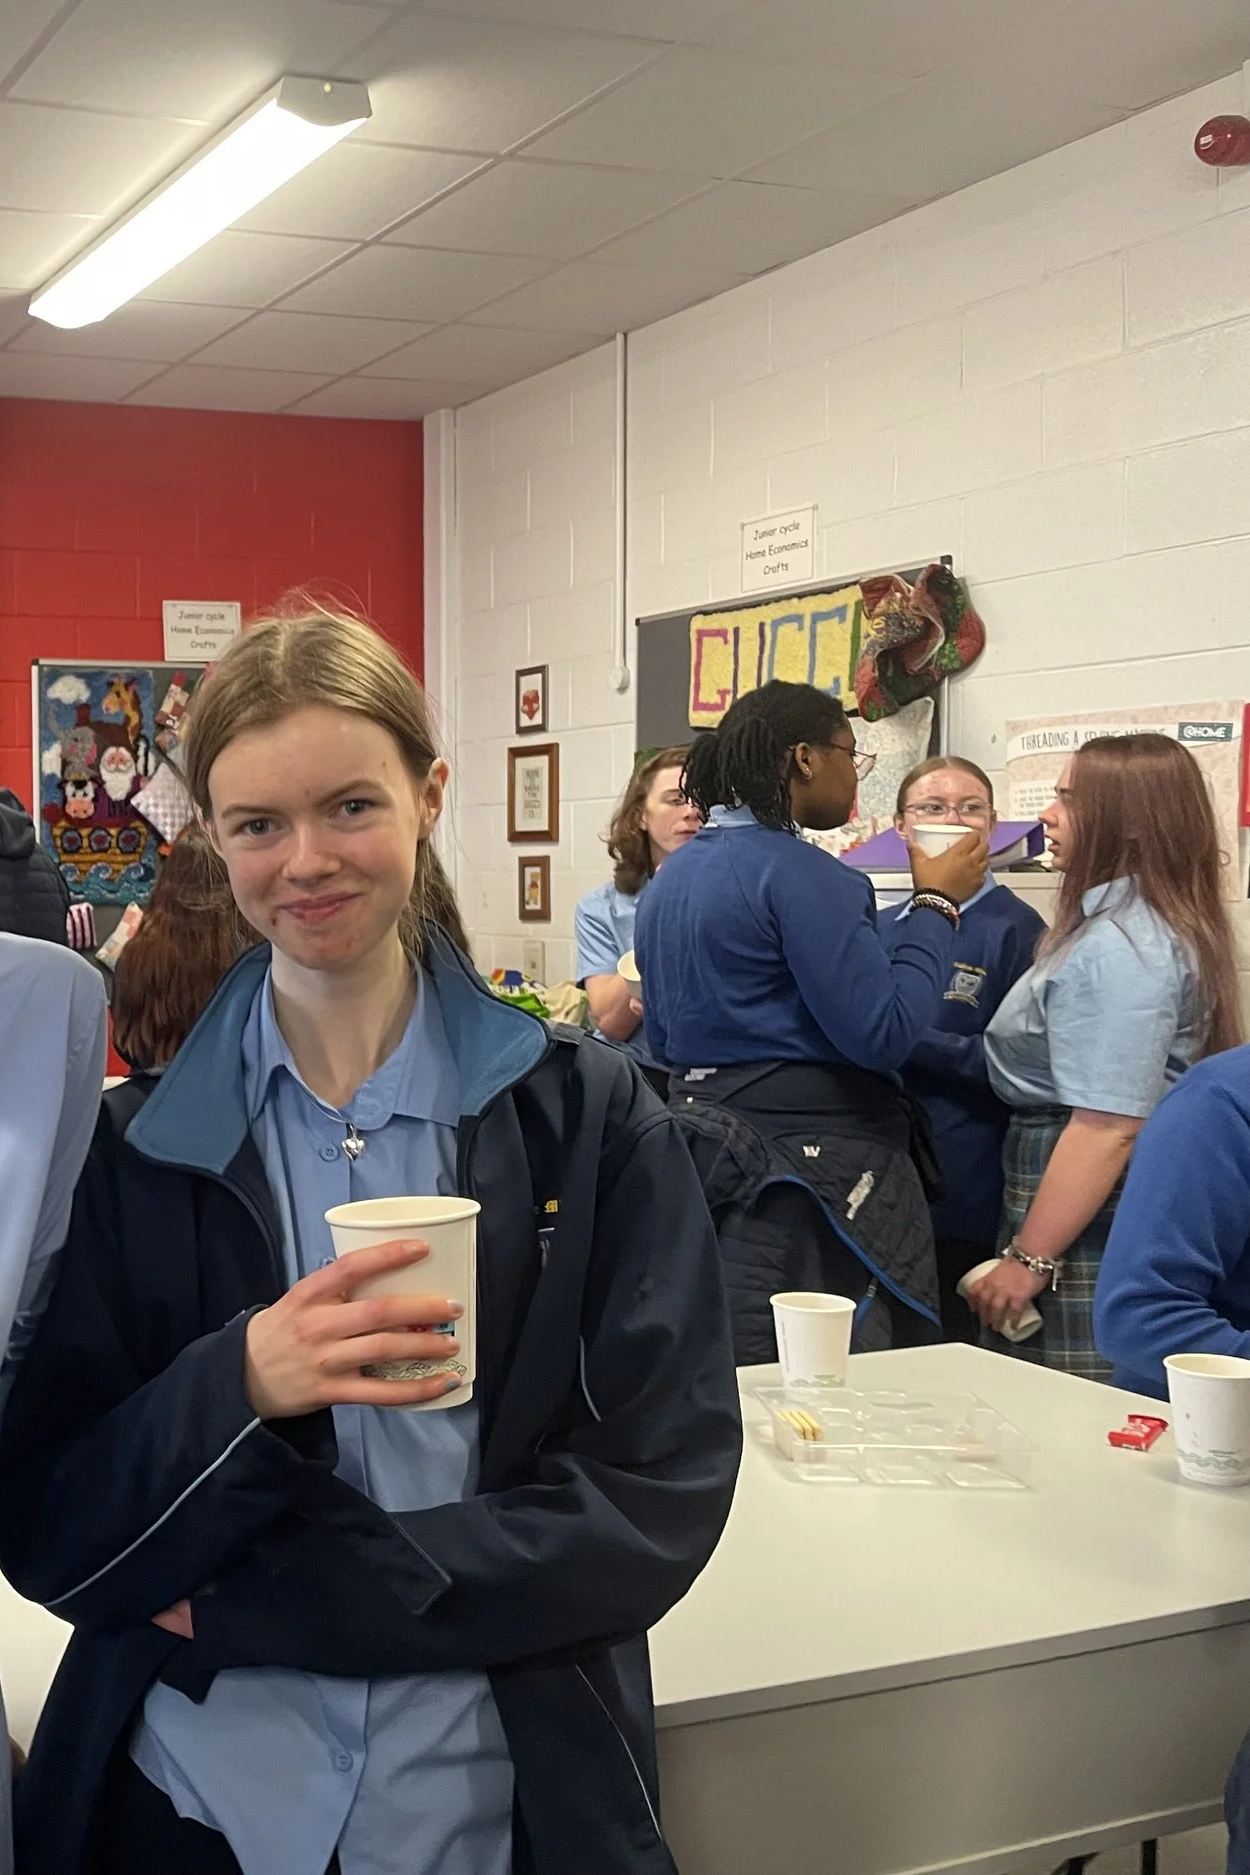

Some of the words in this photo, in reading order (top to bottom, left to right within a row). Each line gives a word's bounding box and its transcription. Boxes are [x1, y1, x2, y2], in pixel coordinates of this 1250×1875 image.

[752, 528, 777, 540] Junior
[779, 520, 800, 535] cycle
[746, 549, 766, 560] Home
[768, 539, 809, 556] Economics
[763, 562, 789, 575] Crafts
[1021, 731, 1069, 750] THREADING
[1073, 730, 1079, 745] A
